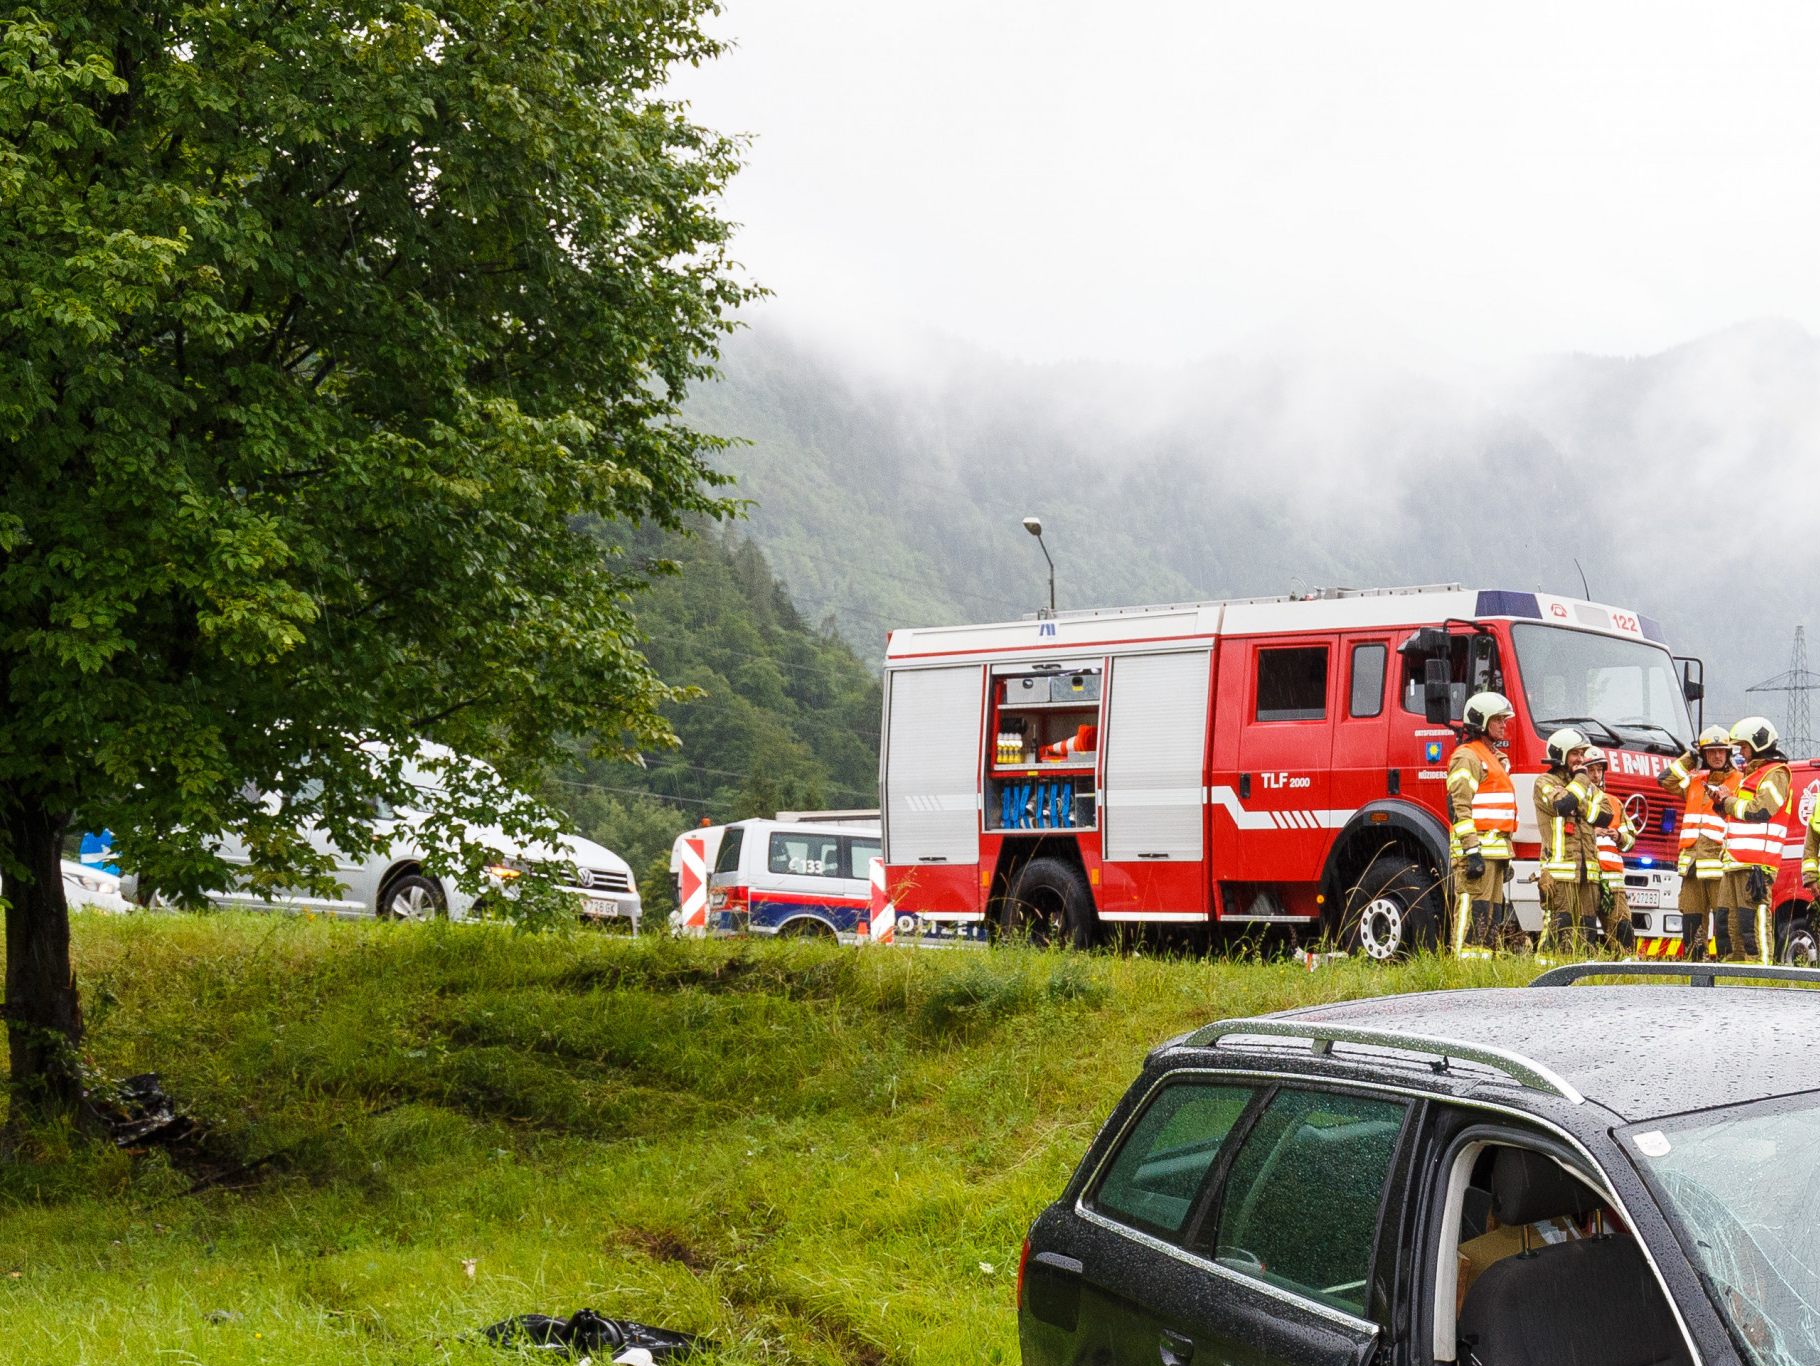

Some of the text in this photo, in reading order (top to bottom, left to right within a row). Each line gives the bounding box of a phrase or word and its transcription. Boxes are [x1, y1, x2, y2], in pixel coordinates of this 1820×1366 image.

[1612, 613, 1638, 632] 122
[1261, 772, 1311, 789] TLF 2000
